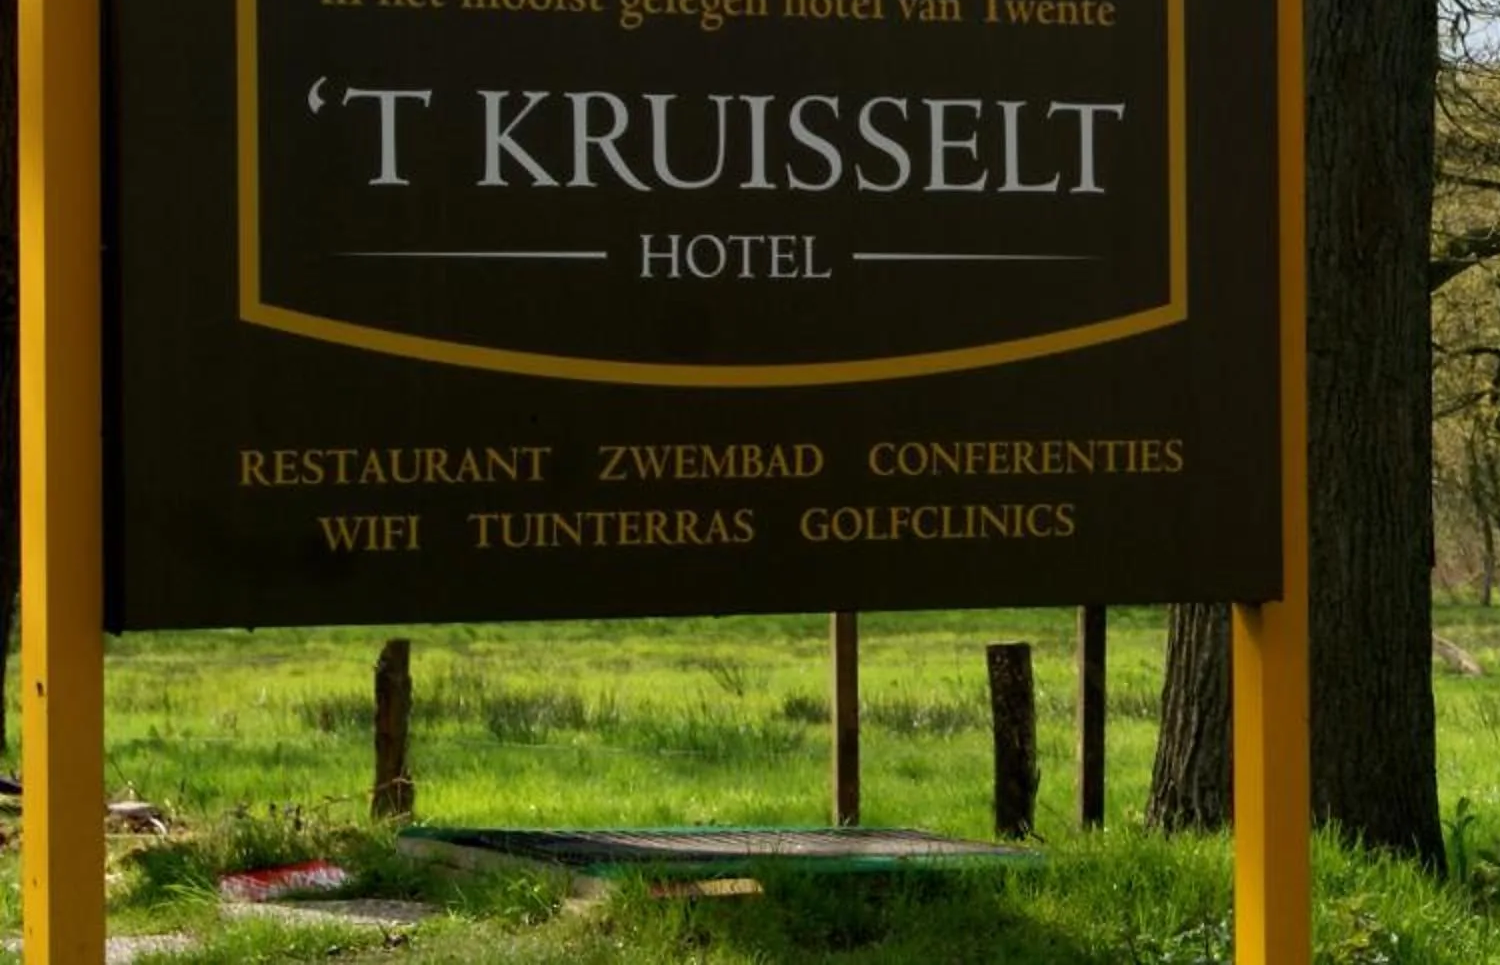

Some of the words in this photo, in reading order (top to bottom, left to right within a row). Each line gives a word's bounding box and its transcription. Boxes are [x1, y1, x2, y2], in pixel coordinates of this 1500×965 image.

[477, 91, 1125, 194] KRUISSELT
[640, 234, 832, 279] HOTEL
[239, 446, 551, 487] RESTAURANT
[599, 444, 824, 481] ZWEMBAD
[867, 439, 1185, 477] CONFERENTIES
[320, 515, 420, 551] WIFI
[471, 510, 755, 547] TUINTERRAS
[800, 505, 1076, 543] GOLFCLINICS
